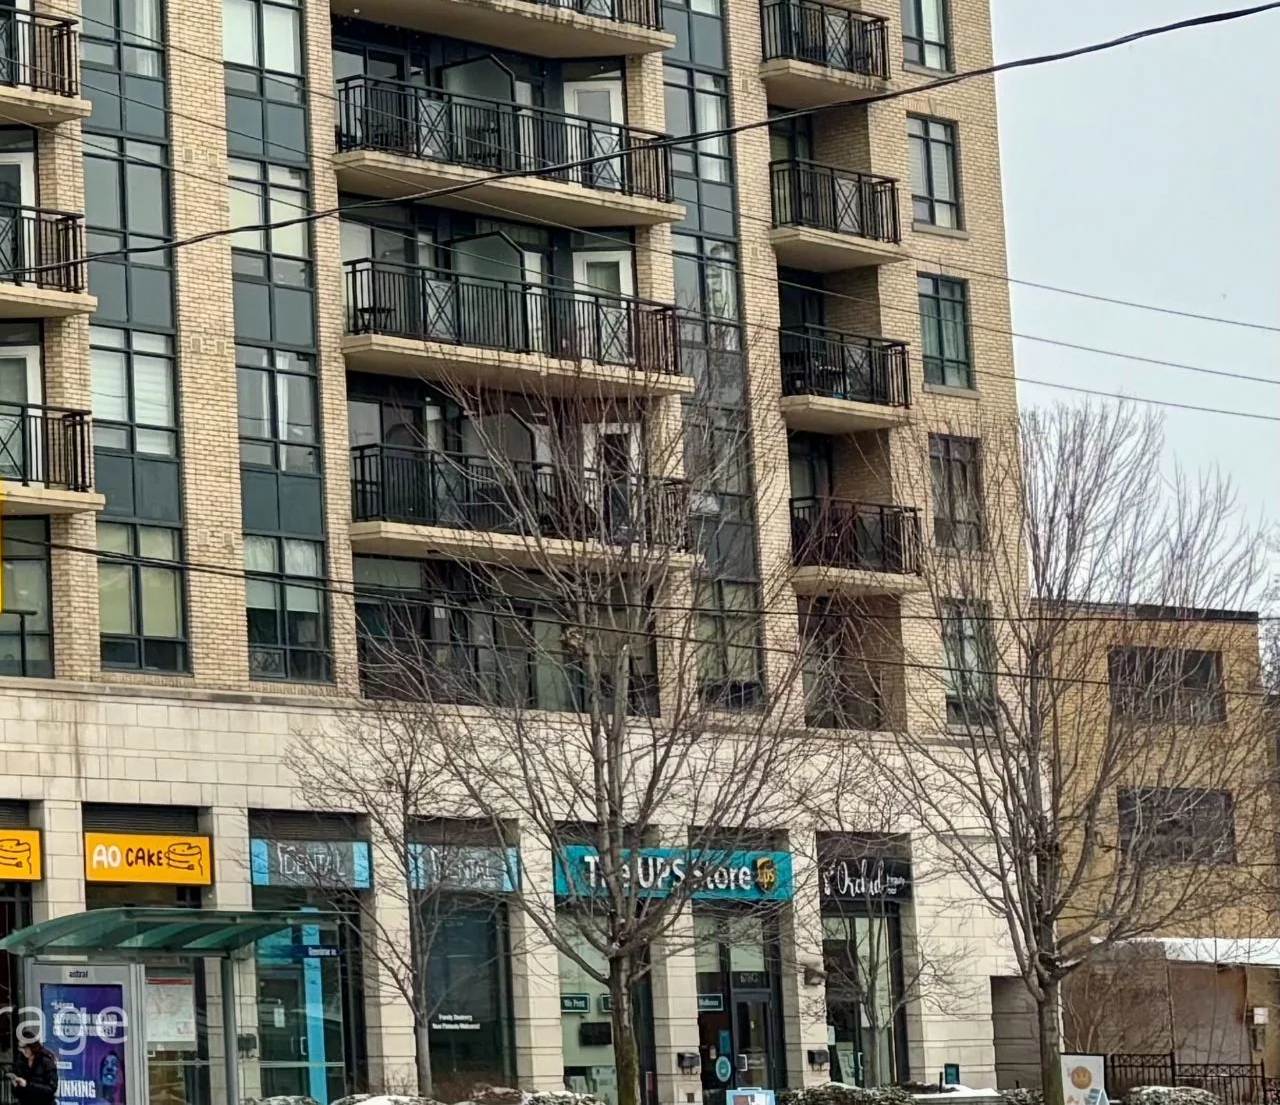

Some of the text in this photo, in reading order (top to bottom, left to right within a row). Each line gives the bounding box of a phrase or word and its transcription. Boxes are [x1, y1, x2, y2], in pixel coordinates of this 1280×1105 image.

[92, 844, 163, 869] AO CAKE
[637, 856, 686, 889] UPS
